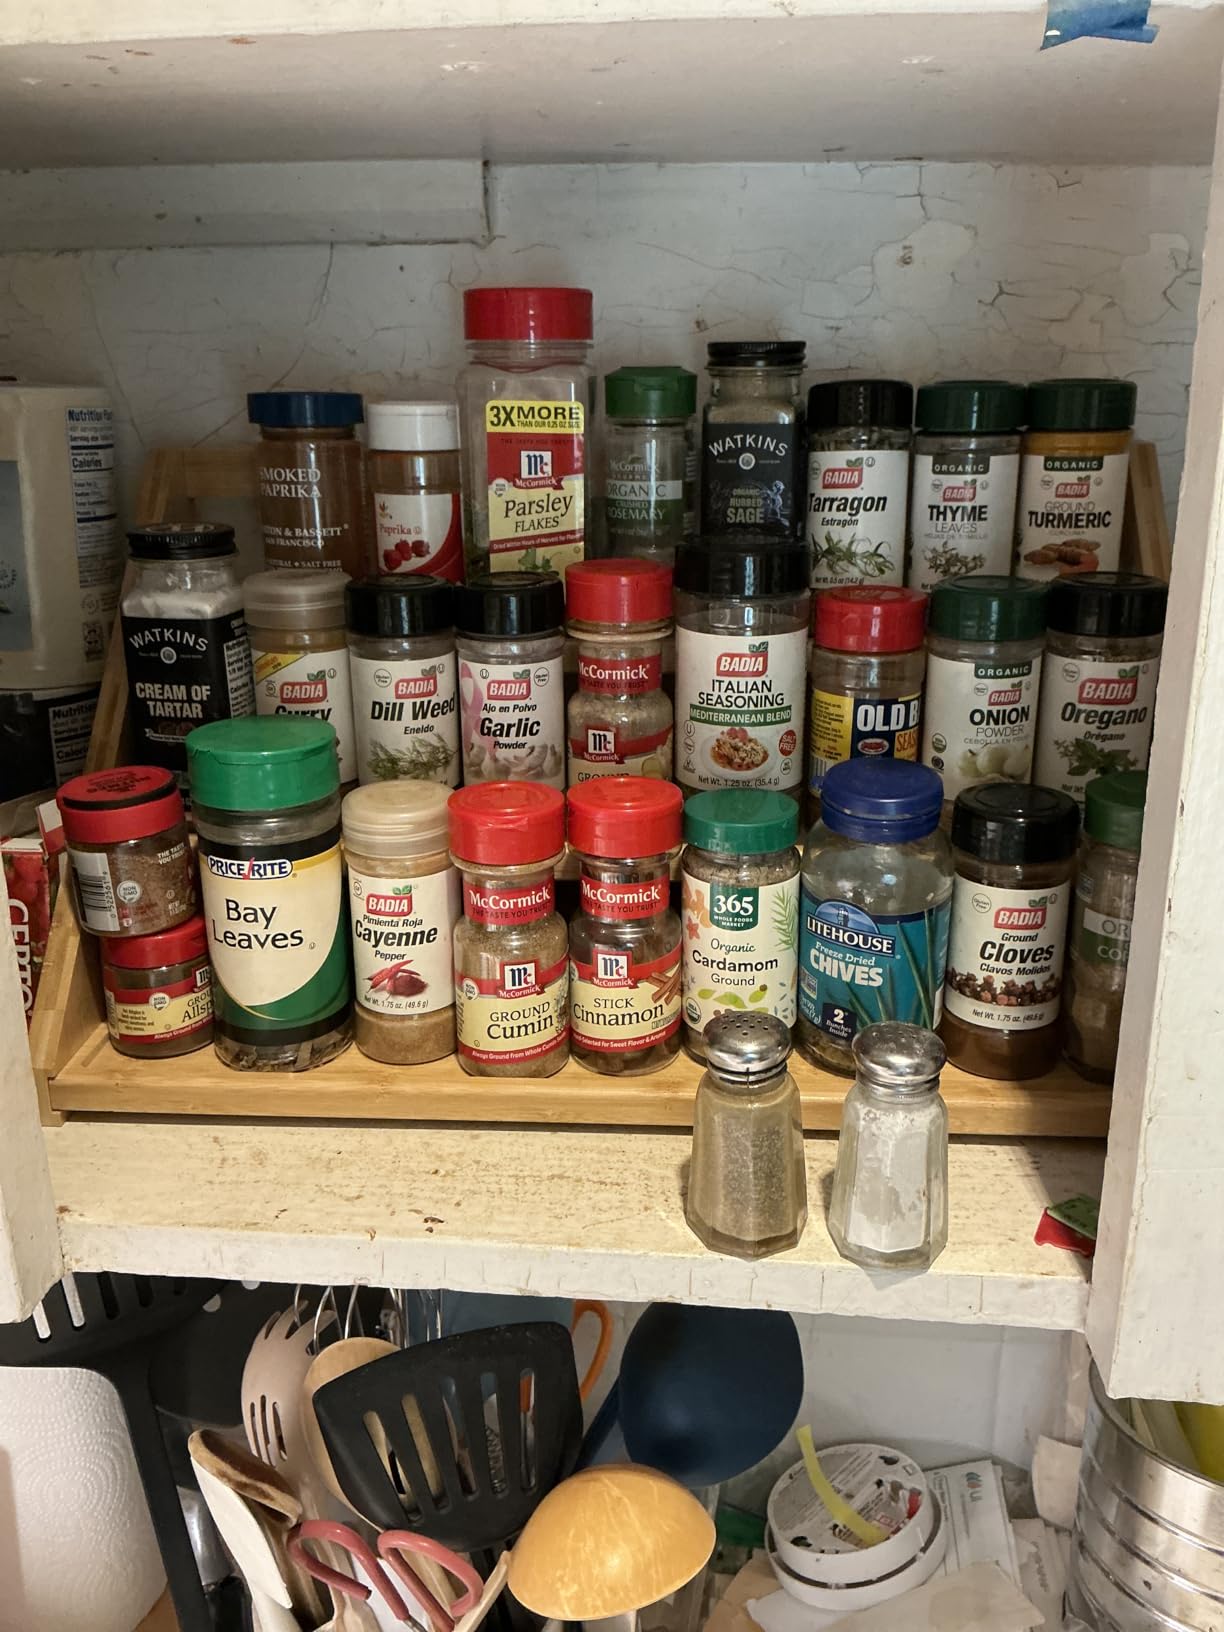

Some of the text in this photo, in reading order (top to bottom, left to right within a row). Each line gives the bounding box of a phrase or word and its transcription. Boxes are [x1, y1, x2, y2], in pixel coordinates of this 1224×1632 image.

[490, 406, 580, 427] 3X MORE
[709, 434, 789, 457] WATKINS
[610, 460, 660, 473] McCormik
[934, 464, 984, 472] ORGANIC
[514, 478, 558, 488] McCormick
[824, 471, 859, 485] BADIA
[608, 483, 667, 498] ORGANC
[945, 488, 974, 499] BADIA
[1057, 485, 1088, 495] BADIA
[504, 493, 573, 518] Parsley
[808, 493, 888, 517] Tarragon
[1045, 501, 1096, 512] GROUND
[726, 508, 765, 523] SAGE
[928, 505, 988, 522] THYME
[1028, 510, 1112, 528] TURMERIC
[295, 527, 341, 537] BASSETT
[380, 524, 412, 536] Paprika
[515, 516, 559, 533] FLAKES
[935, 523, 977, 533] LEAVES
[276, 538, 325, 547] FRANCISCO
[130, 628, 209, 652] WATKINS
[578, 660, 649, 680] McCormick
[720, 656, 763, 672] BADIA
[978, 666, 1030, 676] ORGANIC
[136, 682, 211, 701] CREAM OF
[283, 684, 323, 699] BADIA
[398, 679, 434, 694] BADIA
[490, 682, 527, 696] BADIA
[712, 679, 773, 694] ITALIAN
[1083, 682, 1133, 699] BADIA
[698, 692, 784, 708] SEASONING
[991, 691, 1020, 703] BADIA
[146, 701, 203, 718] TARTAR
[371, 692, 455, 721] Dill Weed
[483, 704, 496, 713] Ajo
[513, 703, 537, 713] Polvo
[691, 708, 791, 723] MEDITERRANEAN BLEND
[857, 703, 906, 731] OLD
[970, 705, 1030, 726] ONION
[1061, 702, 1148, 730] Oregano
[404, 724, 435, 735] Eneldo
[480, 717, 540, 738] Garlic
[976, 725, 1025, 738] POWDER
[494, 740, 528, 750] Powder
[780, 743, 795, 751] FREE
[781, 735, 796, 744] SALT
[698, 776, 709, 785] Net
[724, 779, 740, 787] 1.25
[754, 777, 773, 788] (35.4
[773, 776, 780, 786] g)
[468, 886, 551, 909] McCormick
[582, 879, 660, 904] McCormick
[368, 896, 409, 913] BADIA
[637, 902, 657, 911] TRUST
[713, 893, 754, 916] 365
[225, 898, 277, 930] Bay
[511, 909, 528, 918] YOU
[997, 910, 1043, 926] BADIA
[362, 914, 423, 929] Pimienta Roja
[212, 918, 304, 950] Leaves
[355, 920, 438, 948] Cayenne
[807, 916, 893, 953] LITEHOUSE
[1001, 932, 1039, 943] Ground
[710, 938, 757, 955] Organic
[815, 941, 876, 966] Freeze Dried
[980, 940, 1055, 964] Cloves
[374, 950, 407, 962] Pepper
[692, 949, 778, 972] Cardamom
[809, 948, 884, 987] CHIVES
[980, 963, 1051, 976] Clavos Molidos
[592, 977, 635, 987] McCormick
[711, 973, 755, 986] Ground
[499, 985, 541, 998] McCormick
[381, 999, 393, 1008] 1.75
[421, 999, 429, 1009] g)
[593, 997, 634, 1009] STICK
[490, 1001, 551, 1022] GROUND
[573, 1003, 664, 1027] Cinnamon
[833, 1008, 844, 1024] 2
[972, 1008, 983, 1018] Net
[984, 1011, 995, 1019] Wt.
[997, 1014, 1011, 1022] 1.75
[487, 1014, 553, 1039] Cumin
[825, 1019, 851, 1033] Bunches
[829, 1027, 848, 1038] Inside
[610, 1040, 627, 1048] Sweet
[627, 1038, 645, 1046] Flavor
[525, 1047, 541, 1057] Whole
